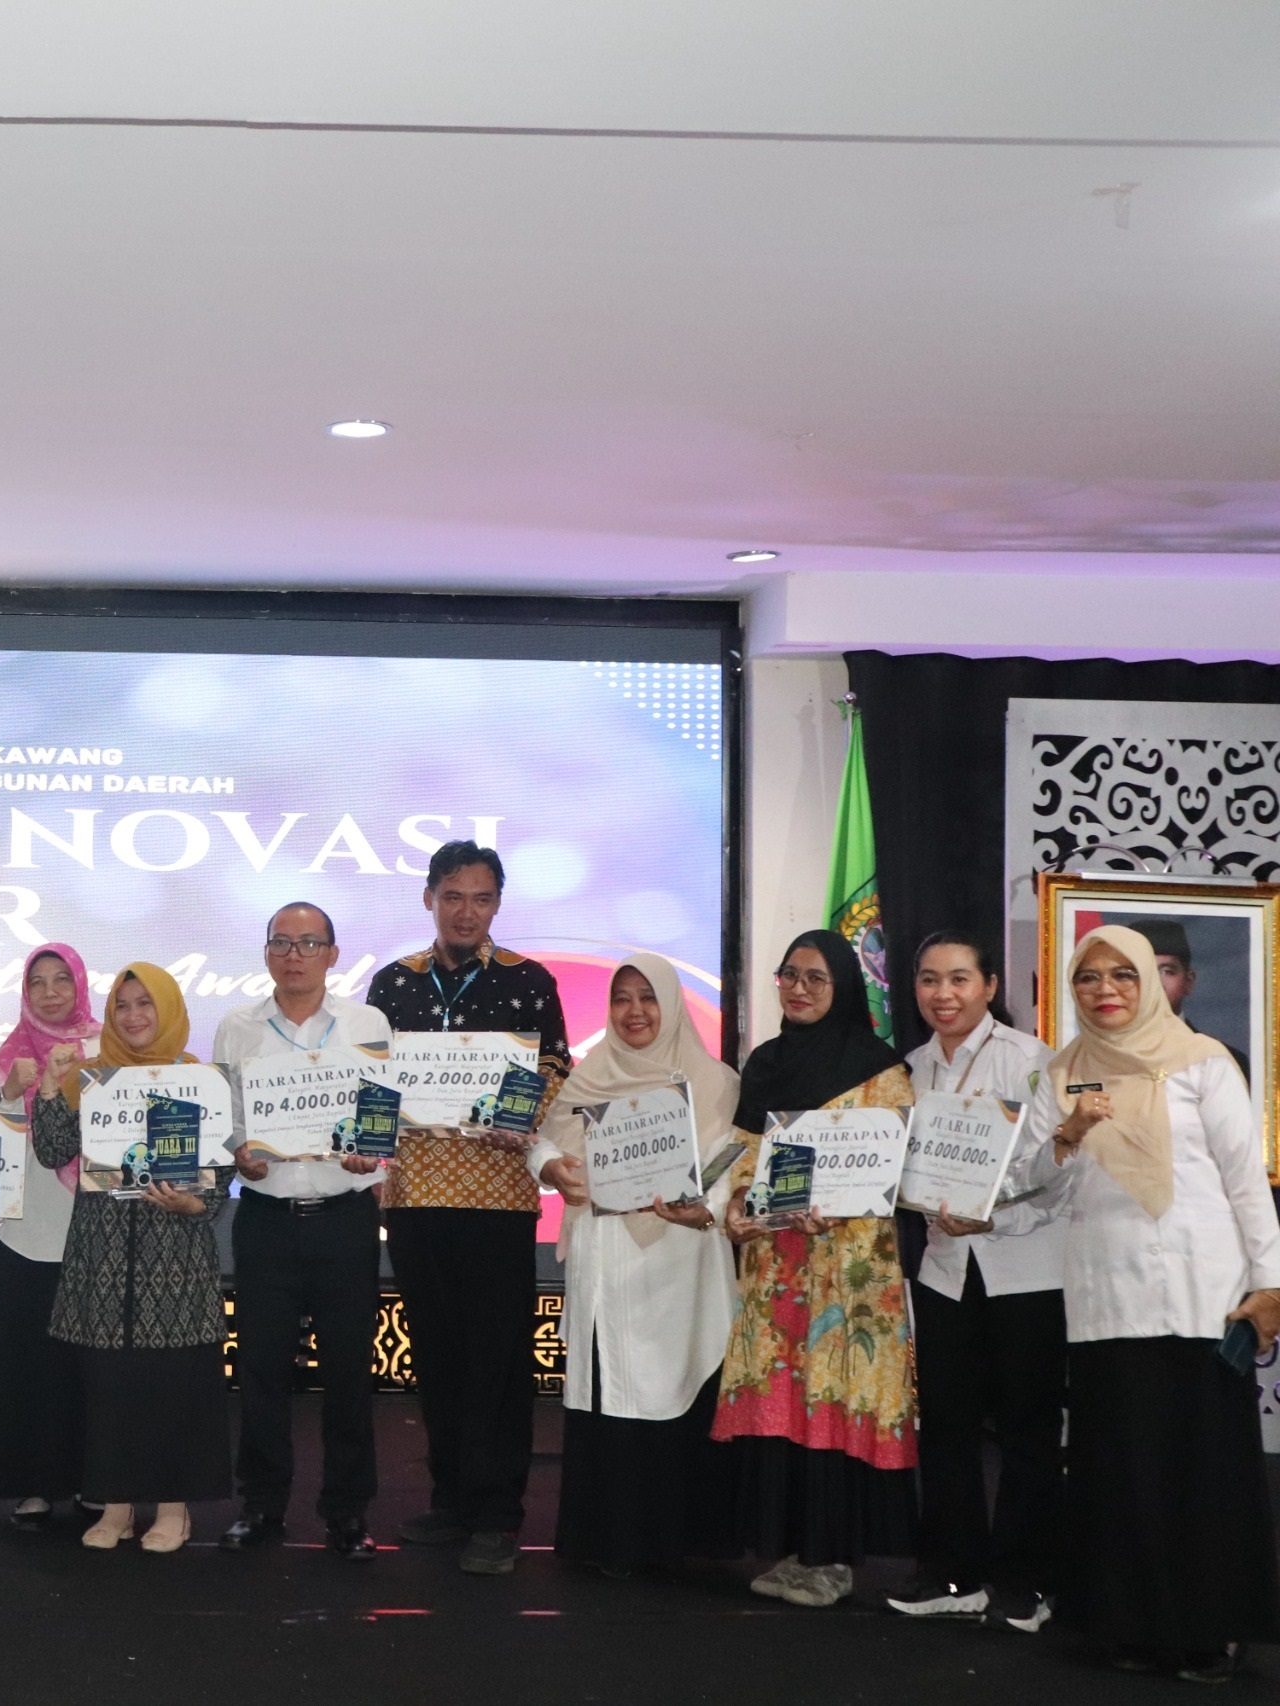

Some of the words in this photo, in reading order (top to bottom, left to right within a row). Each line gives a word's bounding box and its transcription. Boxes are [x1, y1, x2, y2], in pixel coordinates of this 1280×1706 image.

[103, 774, 235, 794] DAERAH
[176, 953, 377, 998] Awad
[392, 1052, 441, 1062] JUARA
[446, 1052, 520, 1062] HARAPAN
[525, 1052, 537, 1062] II
[246, 1075, 297, 1090] JUARA
[302, 1066, 376, 1084] HARAPAN
[397, 1071, 419, 1088] Rp
[422, 1071, 501, 1086] 2.000.00
[178, 1086, 199, 1097] III
[253, 1100, 274, 1117] Rp
[280, 1090, 358, 1112] 4.000.00
[91, 1111, 112, 1128] Rp
[588, 1124, 622, 1140] JUARA
[624, 1110, 676, 1132] HARAPAN
[929, 1116, 970, 1134] JUARA
[974, 1123, 992, 1138] III
[155, 1138, 181, 1155] JUARA
[185, 1137, 196, 1153] III
[767, 1130, 814, 1143] JUARA
[818, 1128, 891, 1143] HARAPAN
[593, 1151, 609, 1170] Rp
[612, 1134, 687, 1164] 2.000.000.-
[907, 1136, 921, 1156] Rp
[923, 1140, 996, 1167] 6.000.000.-
